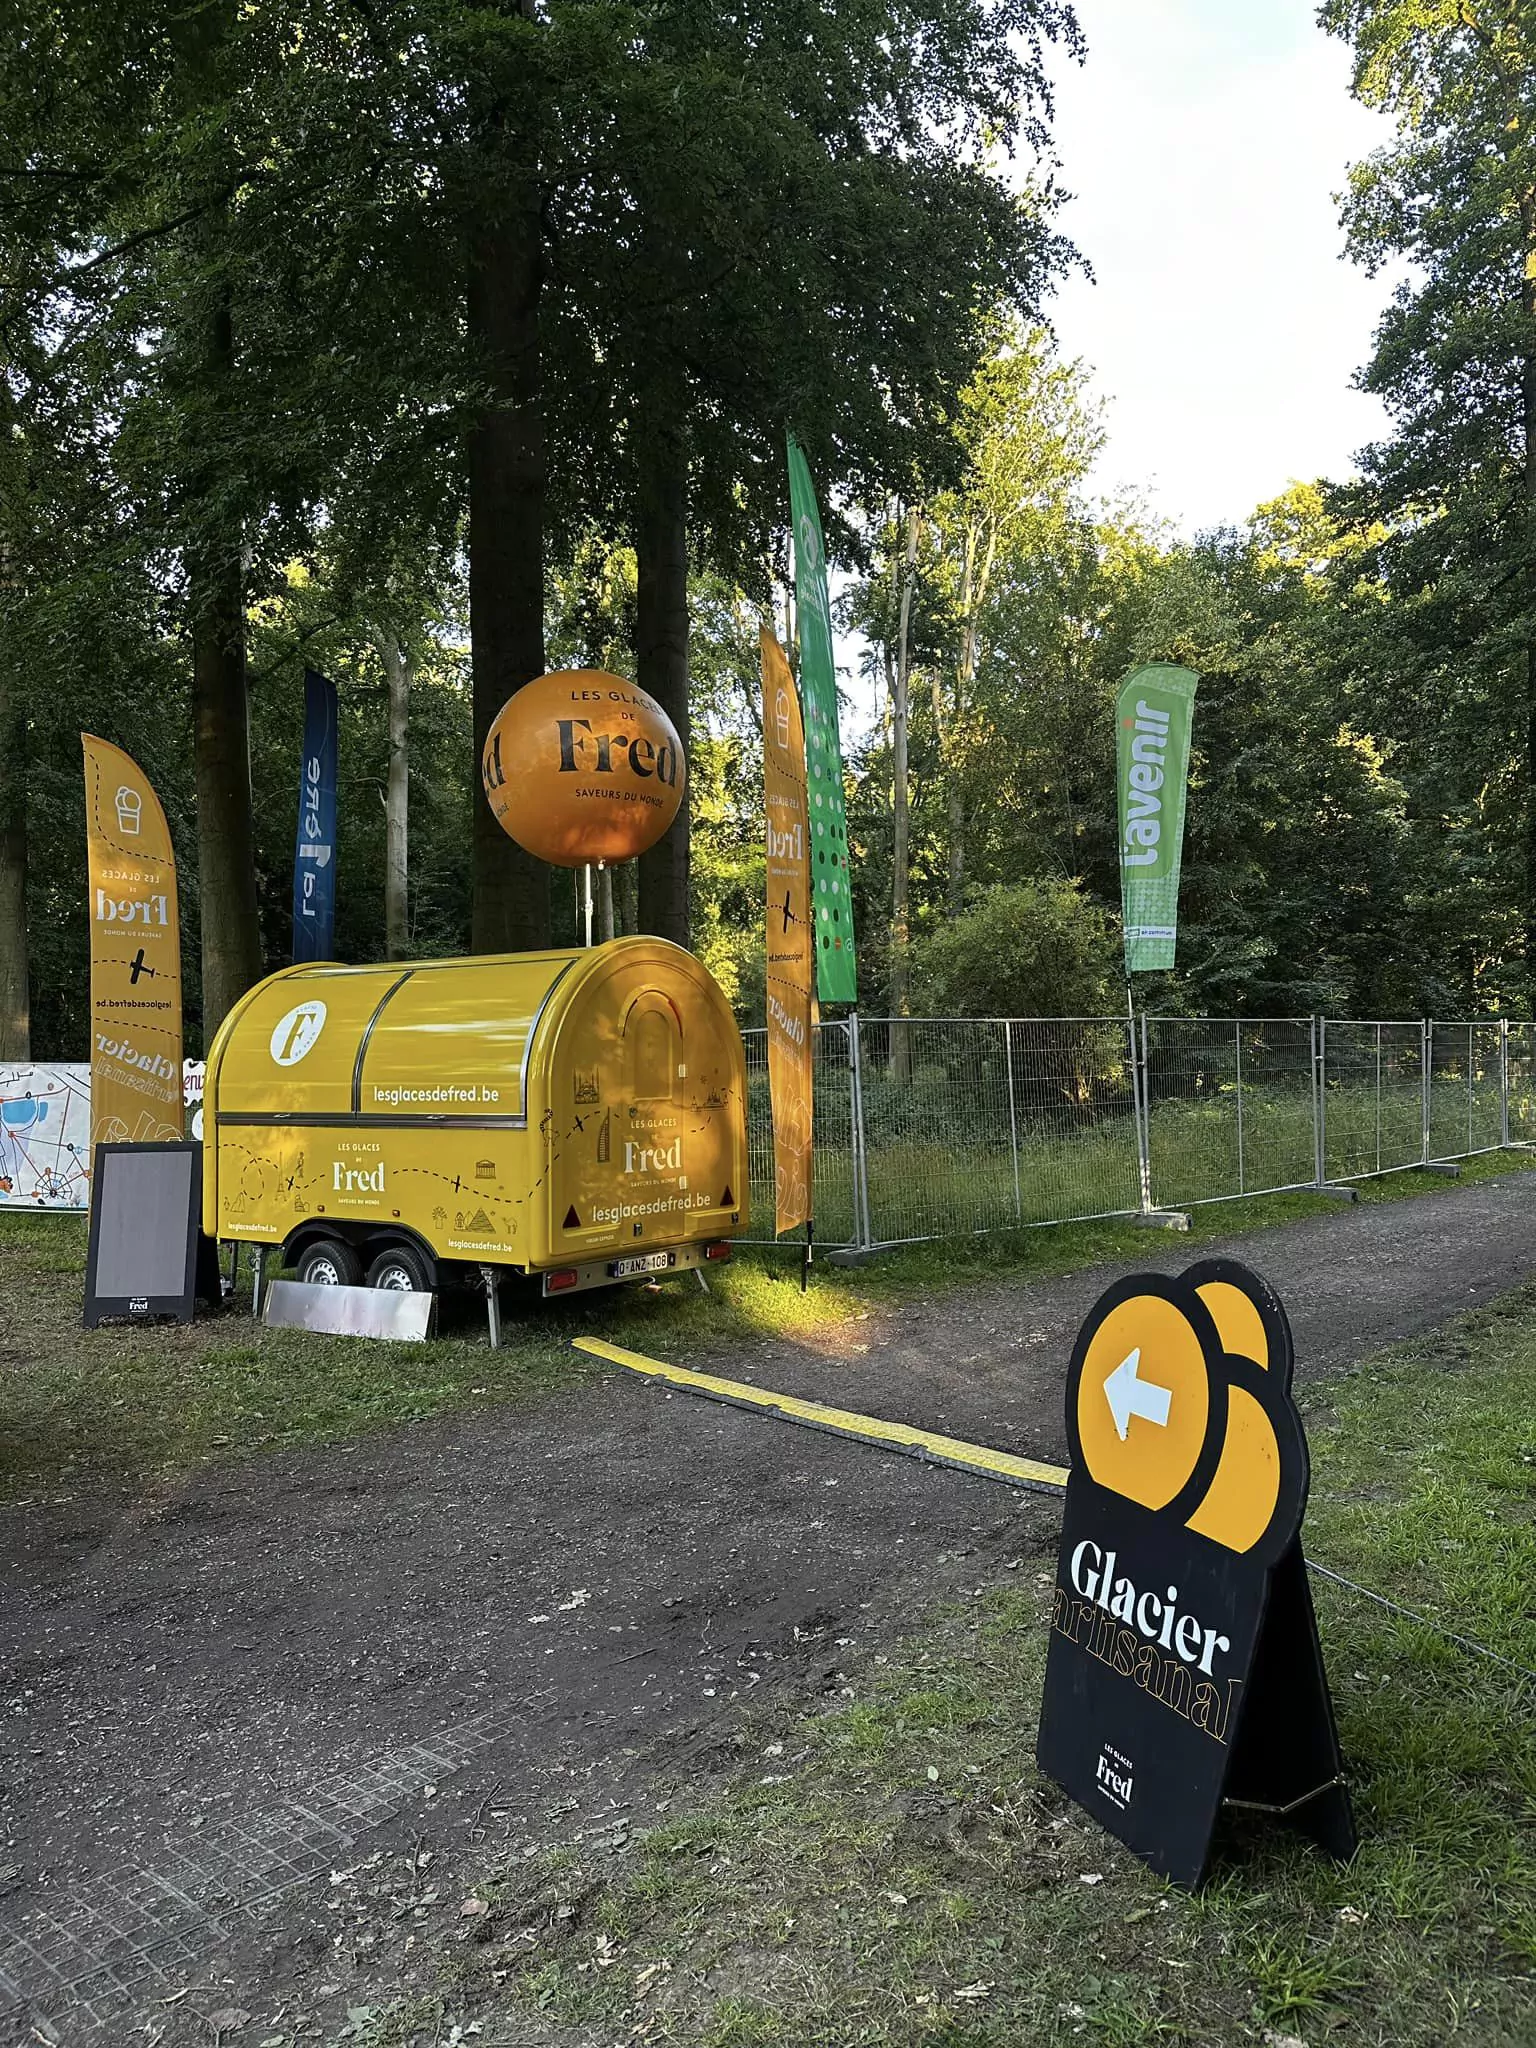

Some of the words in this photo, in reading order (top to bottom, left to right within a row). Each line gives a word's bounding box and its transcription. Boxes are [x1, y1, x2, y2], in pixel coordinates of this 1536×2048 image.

[571, 690, 601, 701] LES
[621, 711, 635, 721] DE
[556, 719, 676, 788] Fred
[575, 789, 621, 799] SAVEURS
[624, 792, 637, 801] DU
[639, 794, 665, 808] MONDE
[279, 1013, 317, 1059] F
[374, 1085, 499, 1106] lesglacesdefred.be
[631, 1119, 645, 1128] LES
[647, 1118, 677, 1128] GLACES
[338, 1143, 350, 1151] LES
[352, 1143, 380, 1152] GLACES
[624, 1136, 682, 1174] Fred
[333, 1161, 385, 1192] Fred
[592, 1193, 711, 1224] lesglacesdefred.be
[1071, 1540, 1230, 1677] Glacier
[1052, 1588, 1243, 1746] artisanal
[1096, 1754, 1133, 1803] Fred
